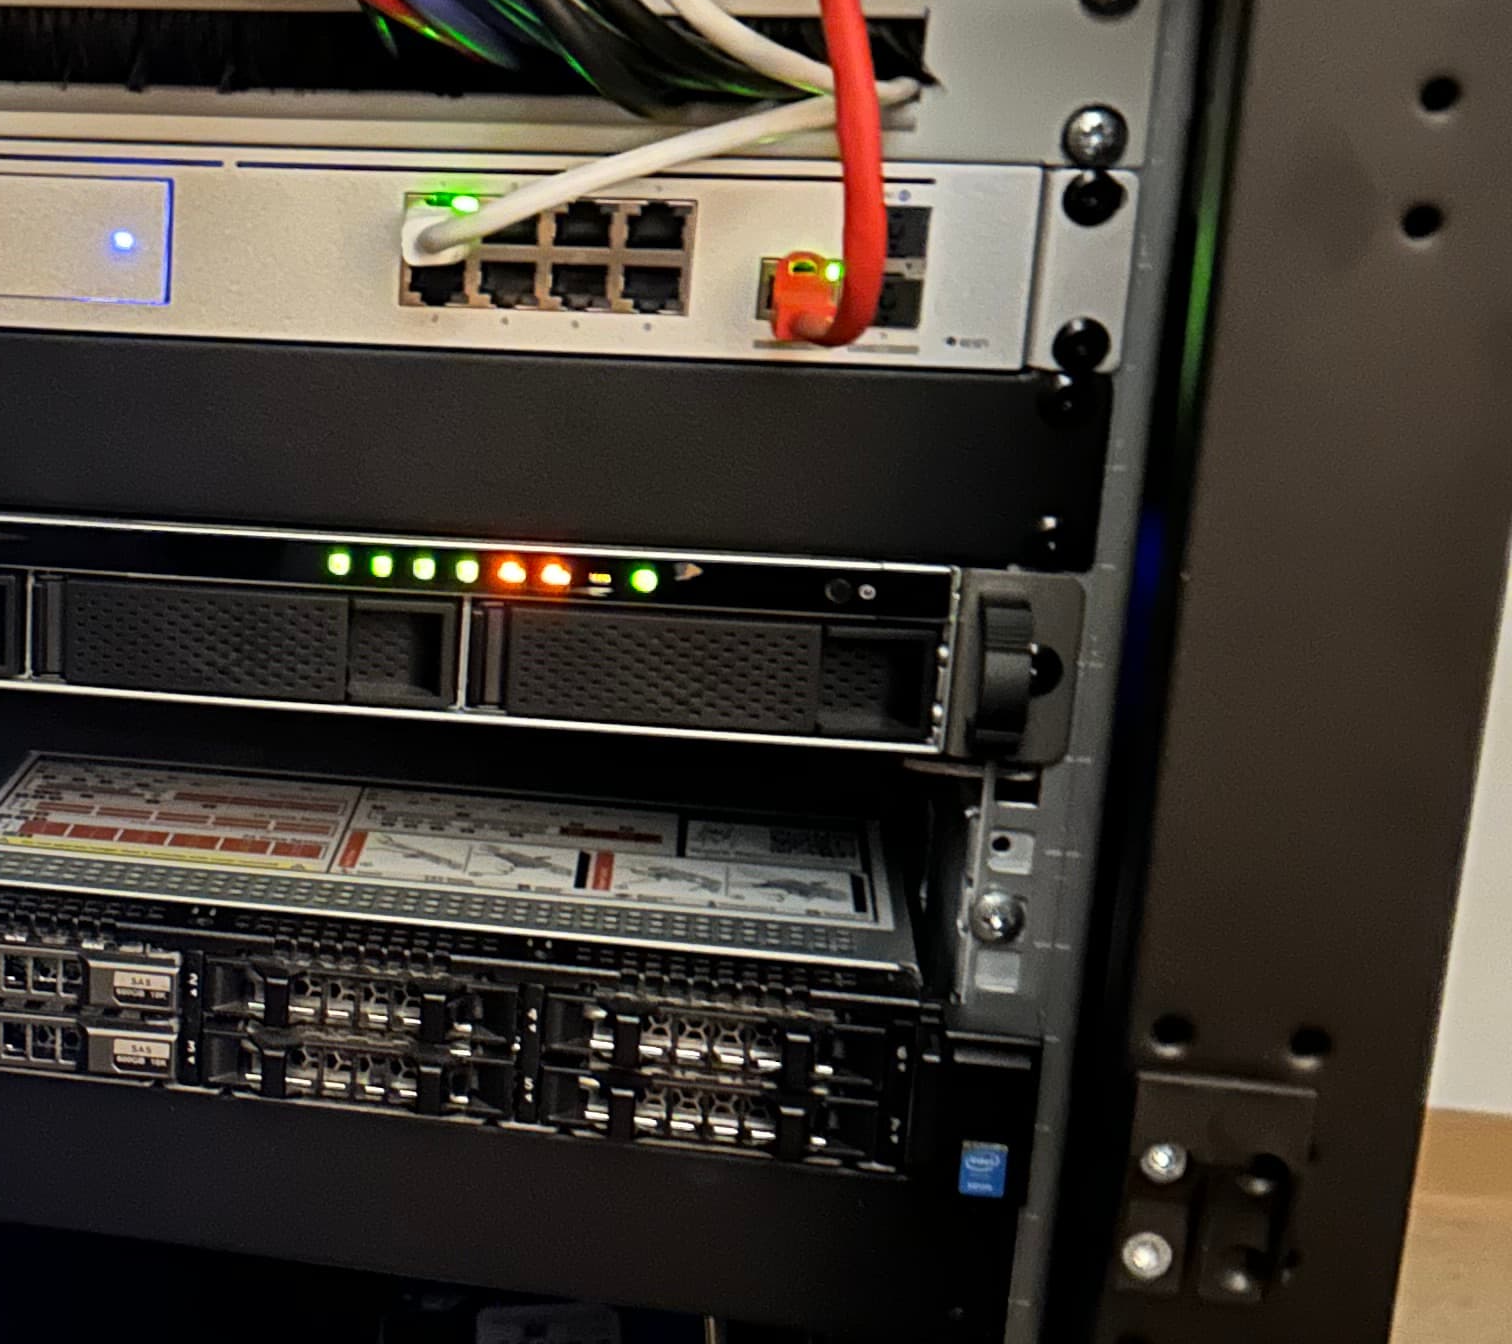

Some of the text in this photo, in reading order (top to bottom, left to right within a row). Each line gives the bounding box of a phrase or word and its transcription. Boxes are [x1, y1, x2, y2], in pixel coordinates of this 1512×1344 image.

[130, 976, 152, 987] SAS
[187, 972, 199, 987] 2
[131, 1044, 152, 1054] SAS
